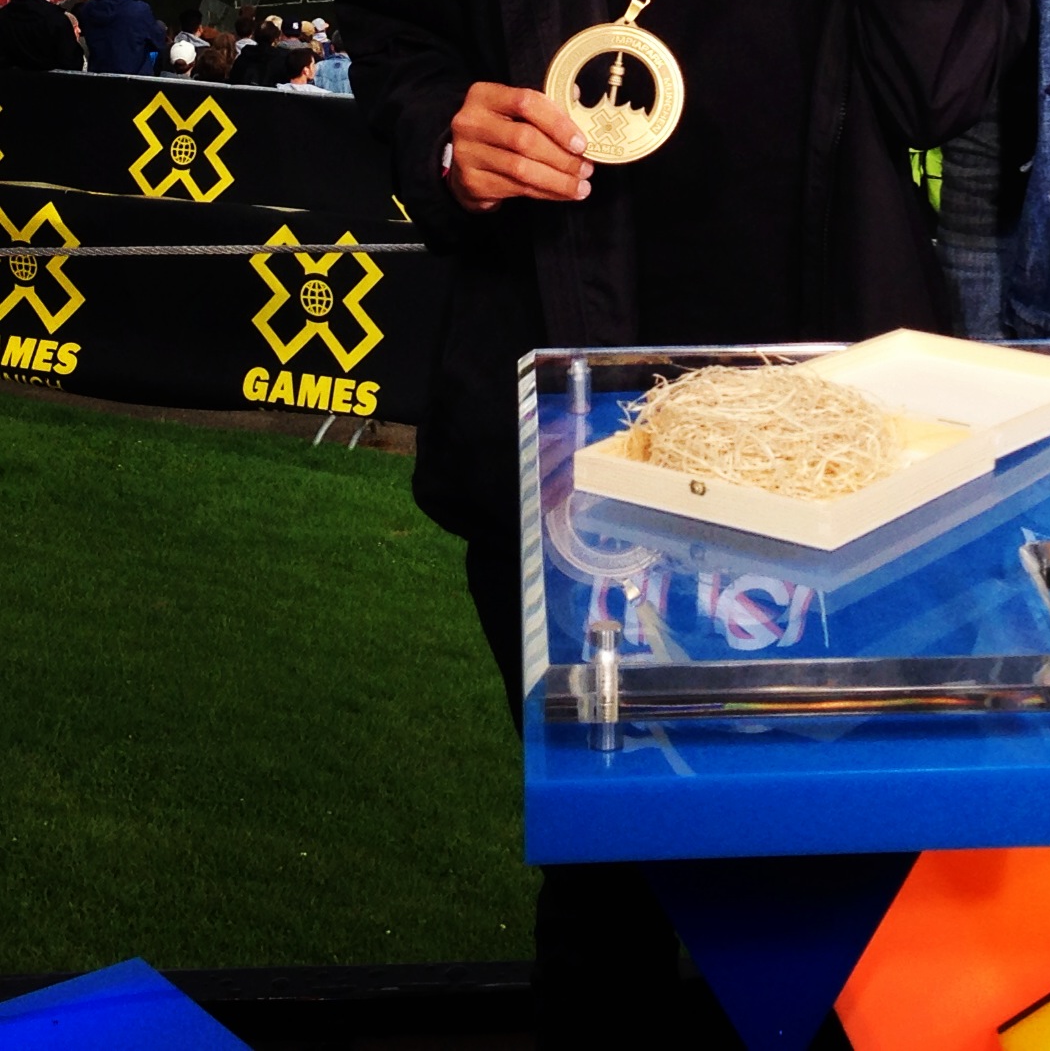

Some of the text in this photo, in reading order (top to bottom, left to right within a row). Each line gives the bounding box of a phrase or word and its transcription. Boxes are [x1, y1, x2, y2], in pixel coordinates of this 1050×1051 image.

[586, 141, 625, 156] GAMES
[1, 335, 82, 375] MES
[242, 367, 381, 416] GAMES
